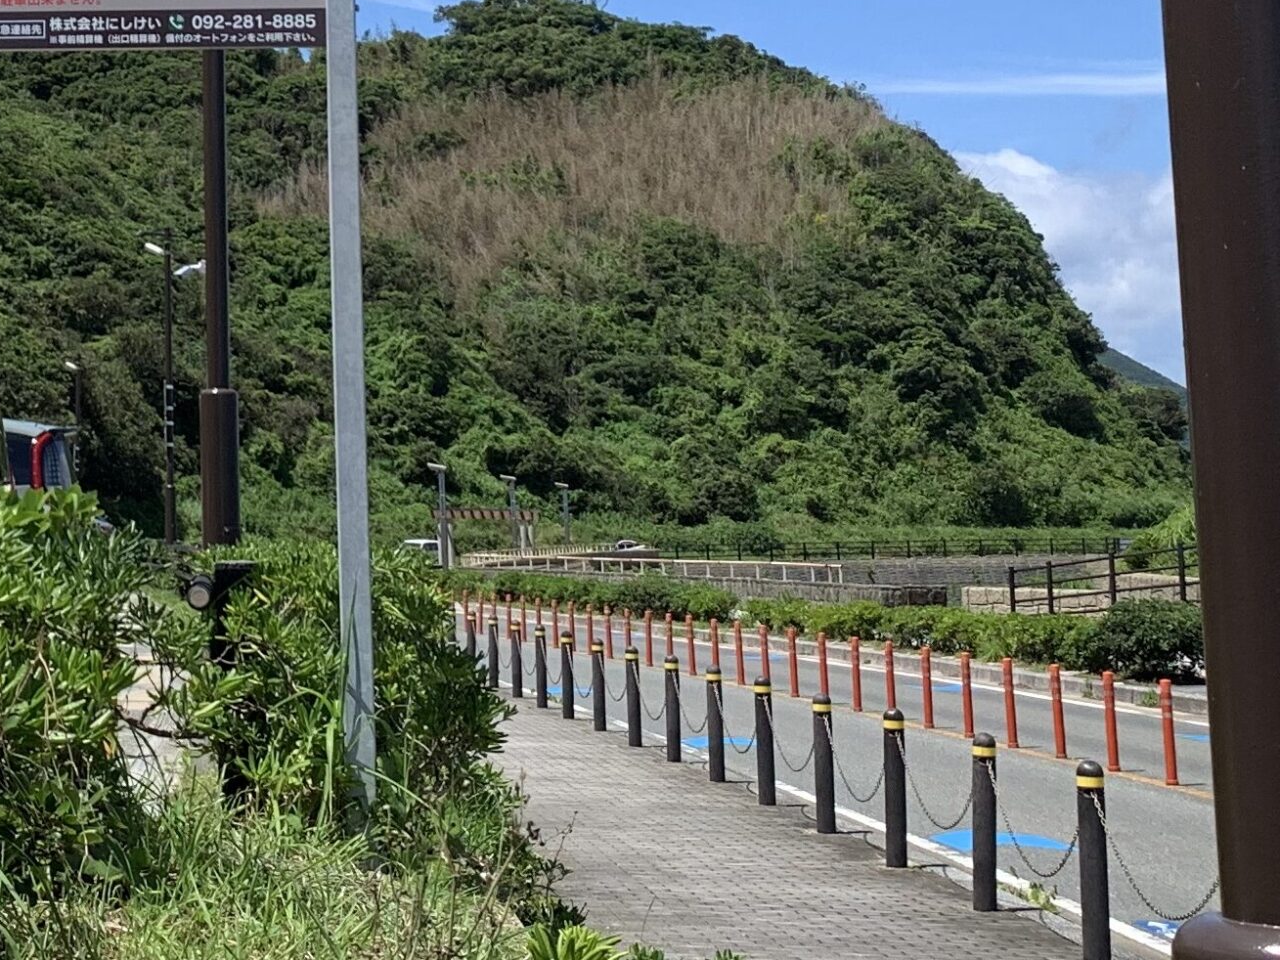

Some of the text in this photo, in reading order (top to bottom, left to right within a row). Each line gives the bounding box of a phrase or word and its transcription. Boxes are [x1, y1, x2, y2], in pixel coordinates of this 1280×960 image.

[49, 16, 162, 31] 株式会社にしけい
[192, 14, 317, 29] 092-281-8885
